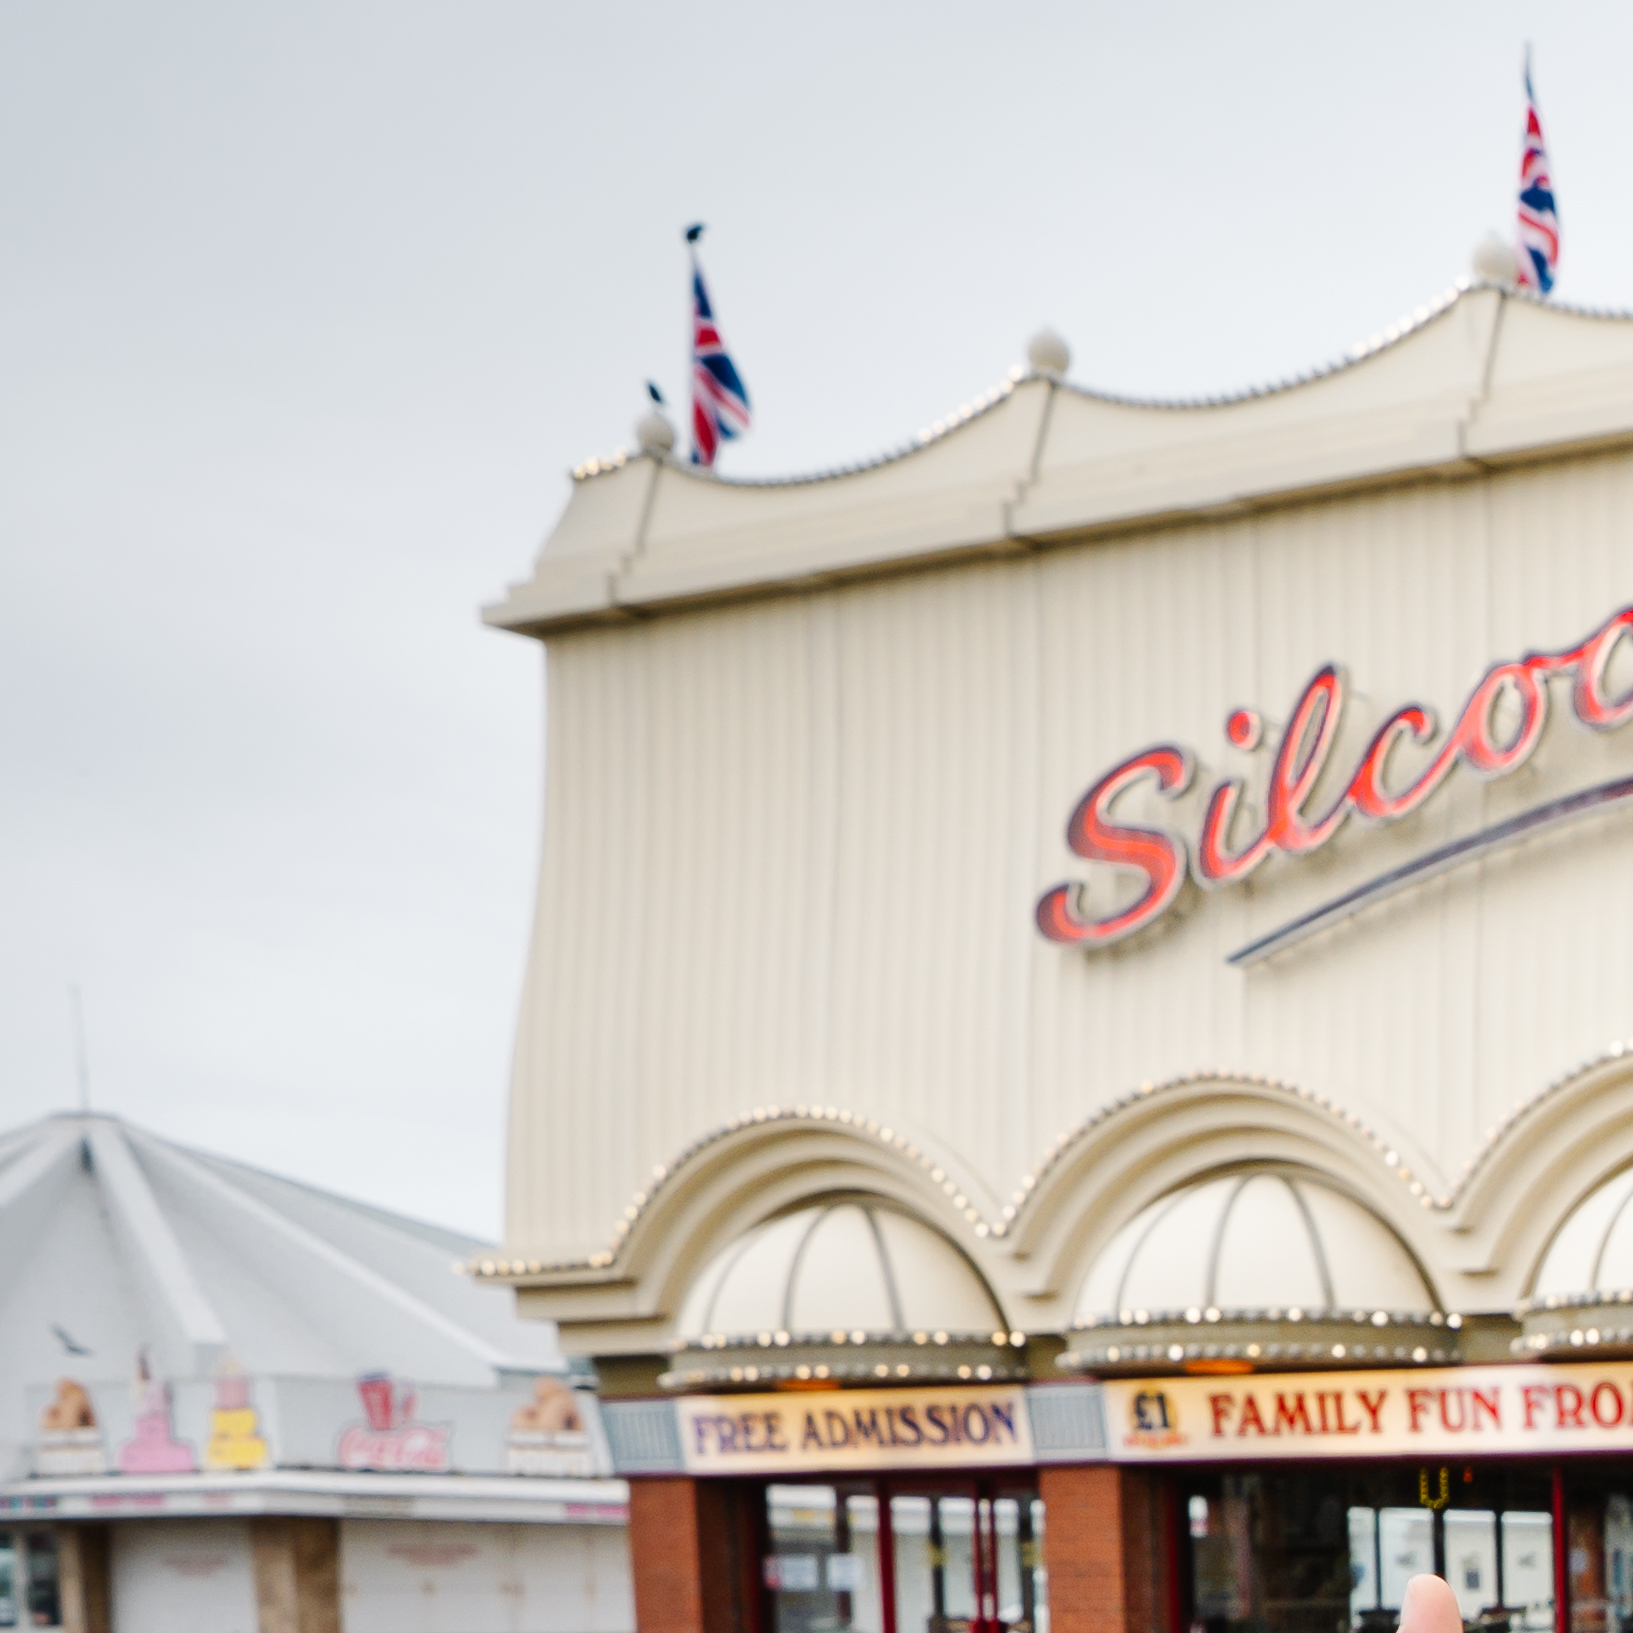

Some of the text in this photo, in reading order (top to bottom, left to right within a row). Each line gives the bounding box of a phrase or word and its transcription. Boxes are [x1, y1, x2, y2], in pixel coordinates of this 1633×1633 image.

[692, 1402, 1019, 1455] FREE ADMISSION
[1208, 1388, 1388, 1438] FAMILY
[1405, 1385, 1503, 1434] FUN
